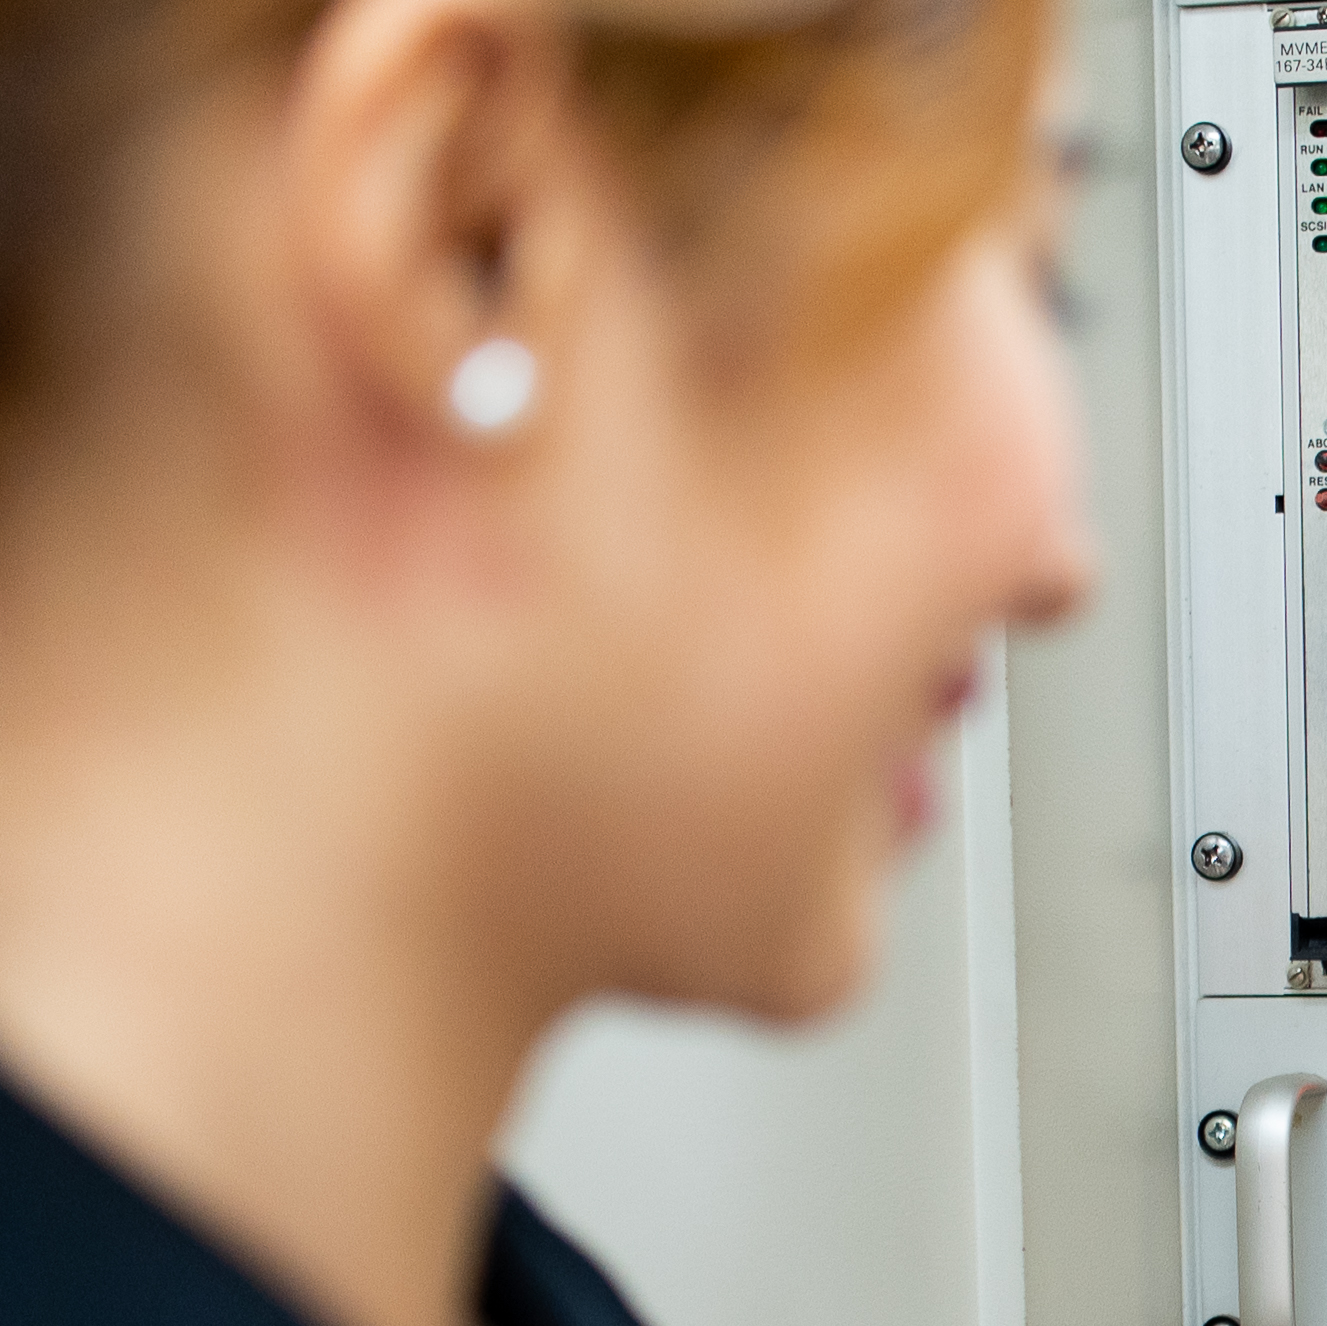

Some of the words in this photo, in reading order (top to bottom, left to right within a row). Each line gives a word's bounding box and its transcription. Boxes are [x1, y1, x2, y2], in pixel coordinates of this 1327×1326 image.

[1280, 41, 1327, 56] MVME
[1299, 105, 1323, 116] FAIL
[1300, 144, 1324, 155] RUN
[1301, 182, 1324, 193] LAN
[1301, 221, 1326, 232] SCSI
